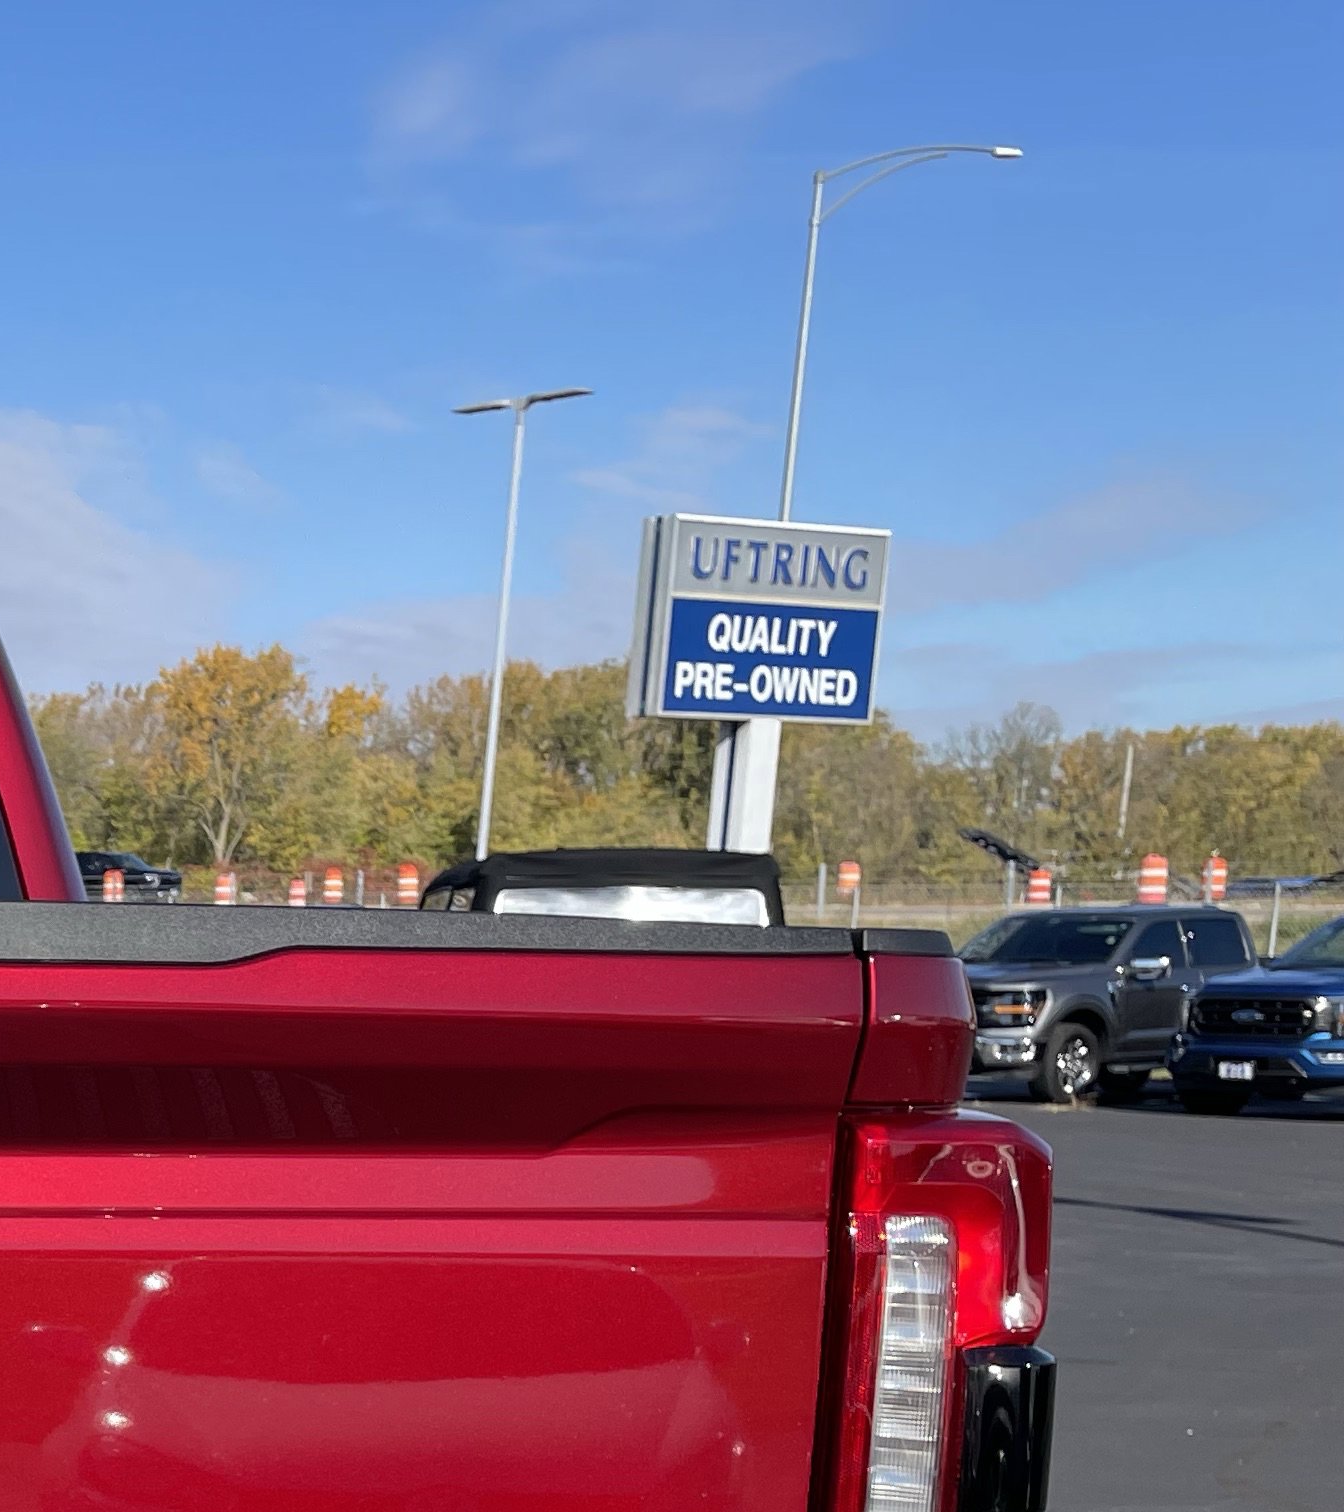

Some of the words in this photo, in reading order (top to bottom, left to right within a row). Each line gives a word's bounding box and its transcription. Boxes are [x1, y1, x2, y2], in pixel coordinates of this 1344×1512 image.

[691, 536, 869, 590] UFTRING
[707, 613, 838, 657] QUALITY
[673, 661, 858, 706] PRE-OWNED
